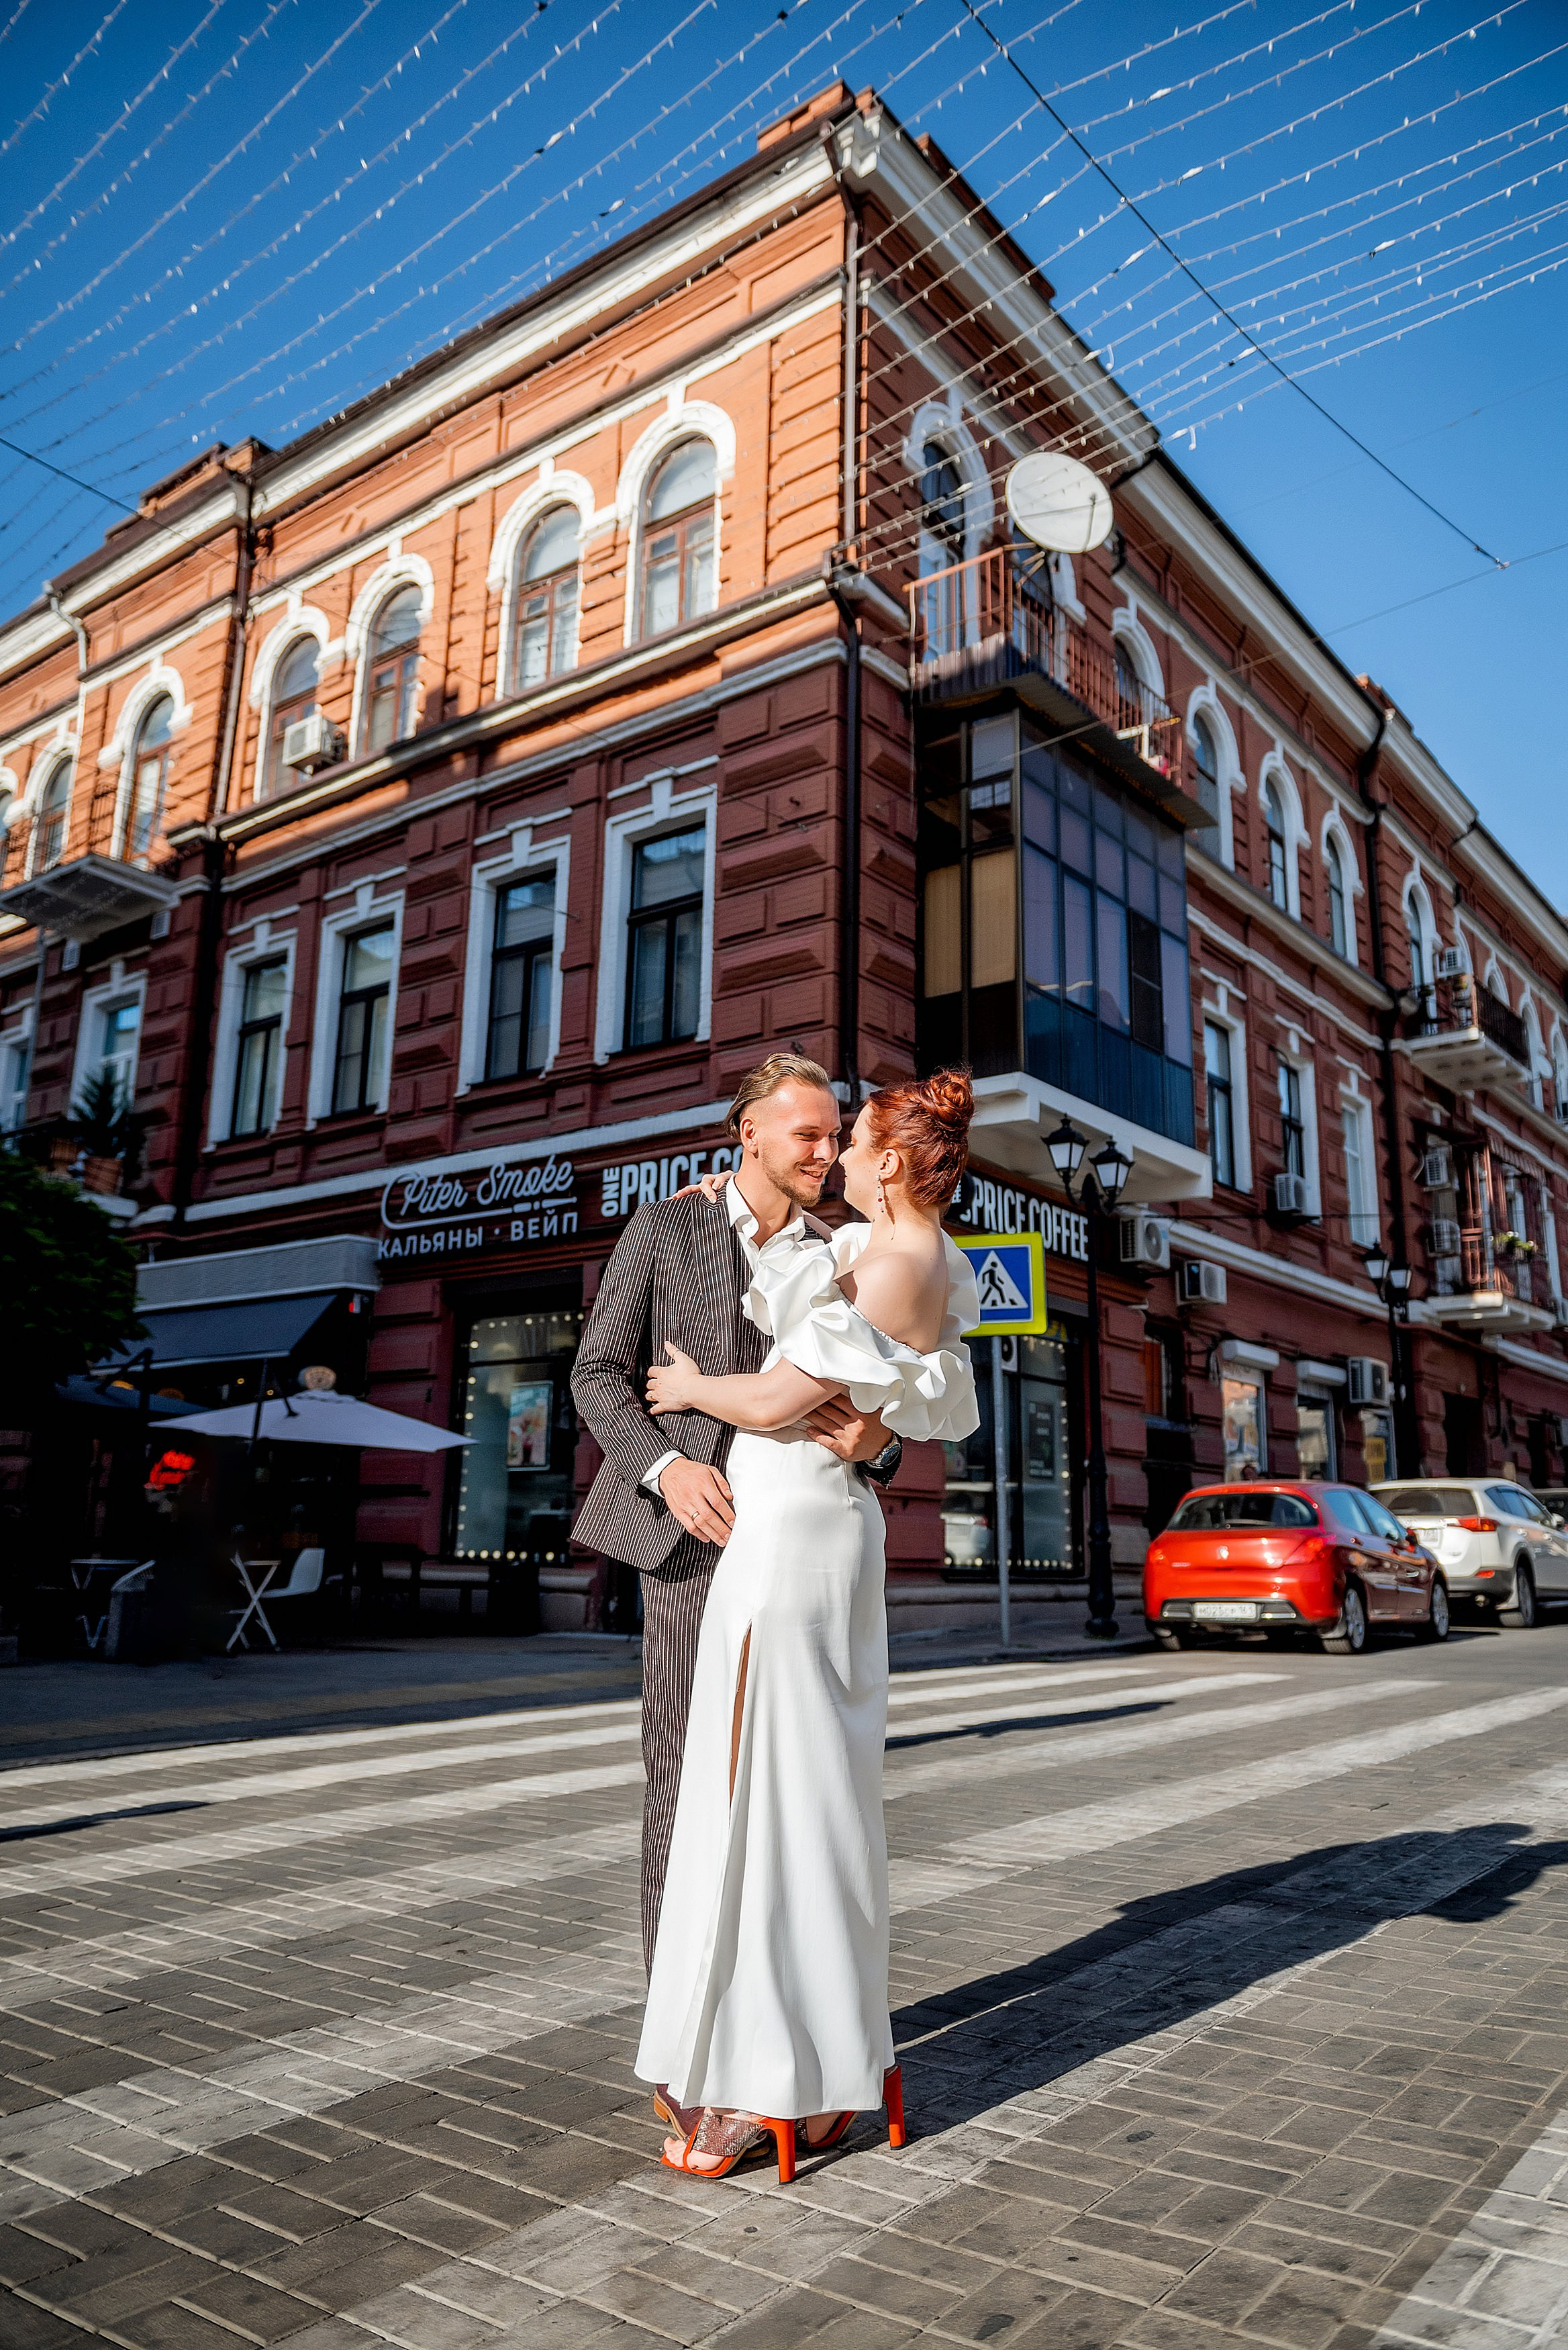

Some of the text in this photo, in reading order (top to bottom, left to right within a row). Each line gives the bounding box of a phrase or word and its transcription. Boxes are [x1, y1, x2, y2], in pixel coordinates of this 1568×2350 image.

[396, 1154, 575, 1216] Piter Smoke
[601, 1166, 620, 1217] ONE
[378, 1208, 579, 1260] КАЛЬЯНЫ ВЕЙП
[971, 1176, 1089, 1262] PRICE COFFEE
